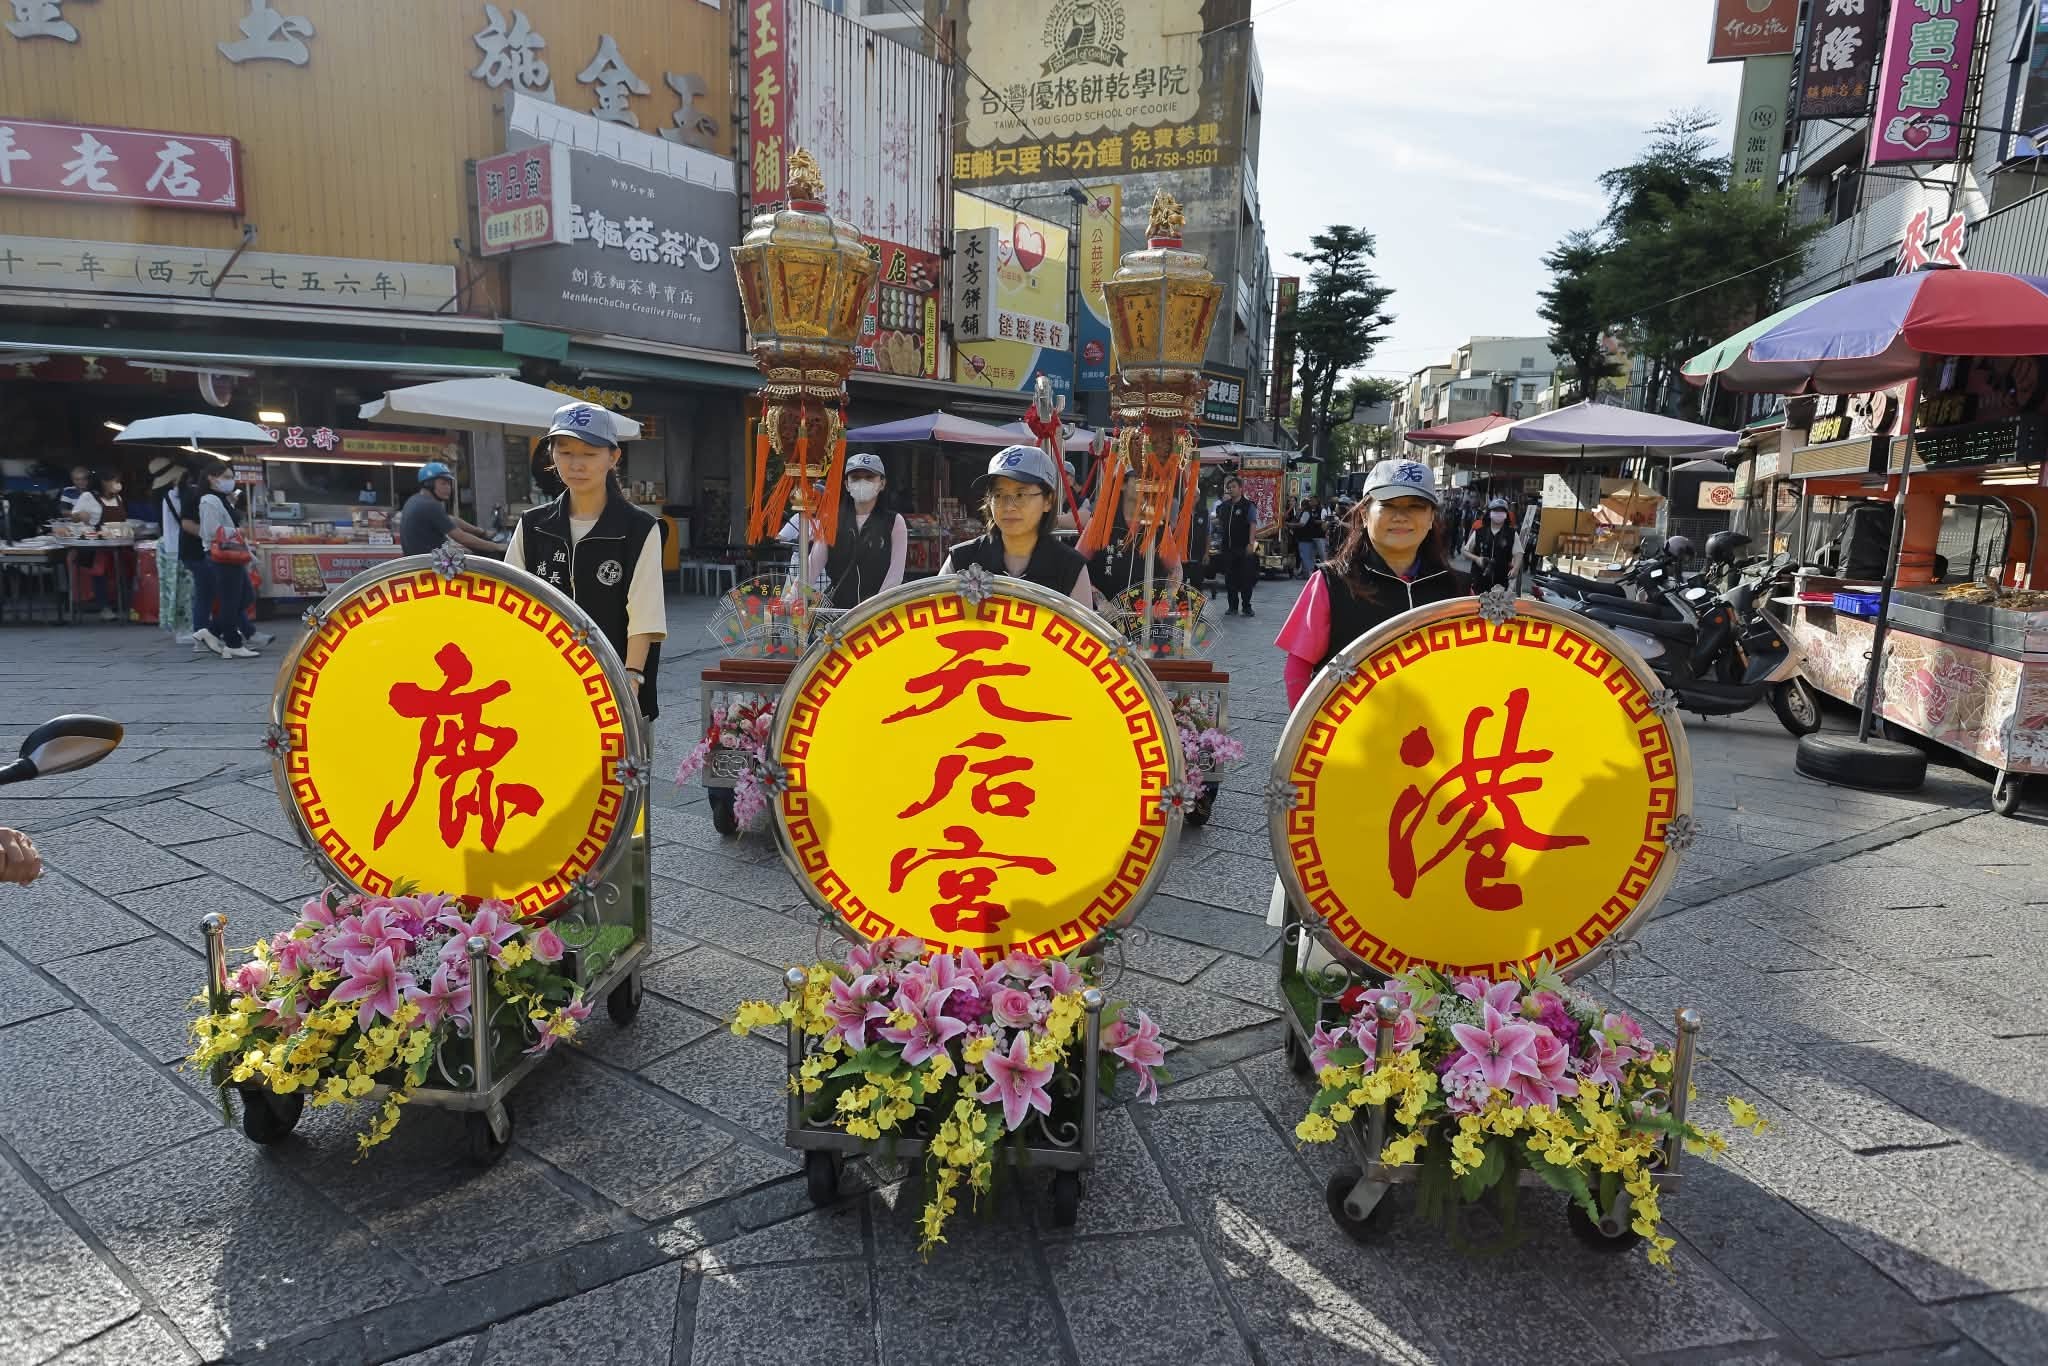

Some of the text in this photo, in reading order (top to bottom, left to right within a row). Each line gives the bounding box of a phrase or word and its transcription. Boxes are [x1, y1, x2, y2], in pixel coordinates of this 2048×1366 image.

[980, 65, 1190, 115] 台灣優格餅乾學院
[994, 102, 1177, 129] TAIWAN YOU GOOD SCHOOL OF COOKIE
[1131, 149, 1219, 170] 04-758-9501
[562, 290, 701, 323] MenMenChaCha Creative Flour Tea
[373, 641, 545, 854] 鹿
[880, 629, 1073, 934] 天后宮
[1387, 687, 1591, 912] 港
